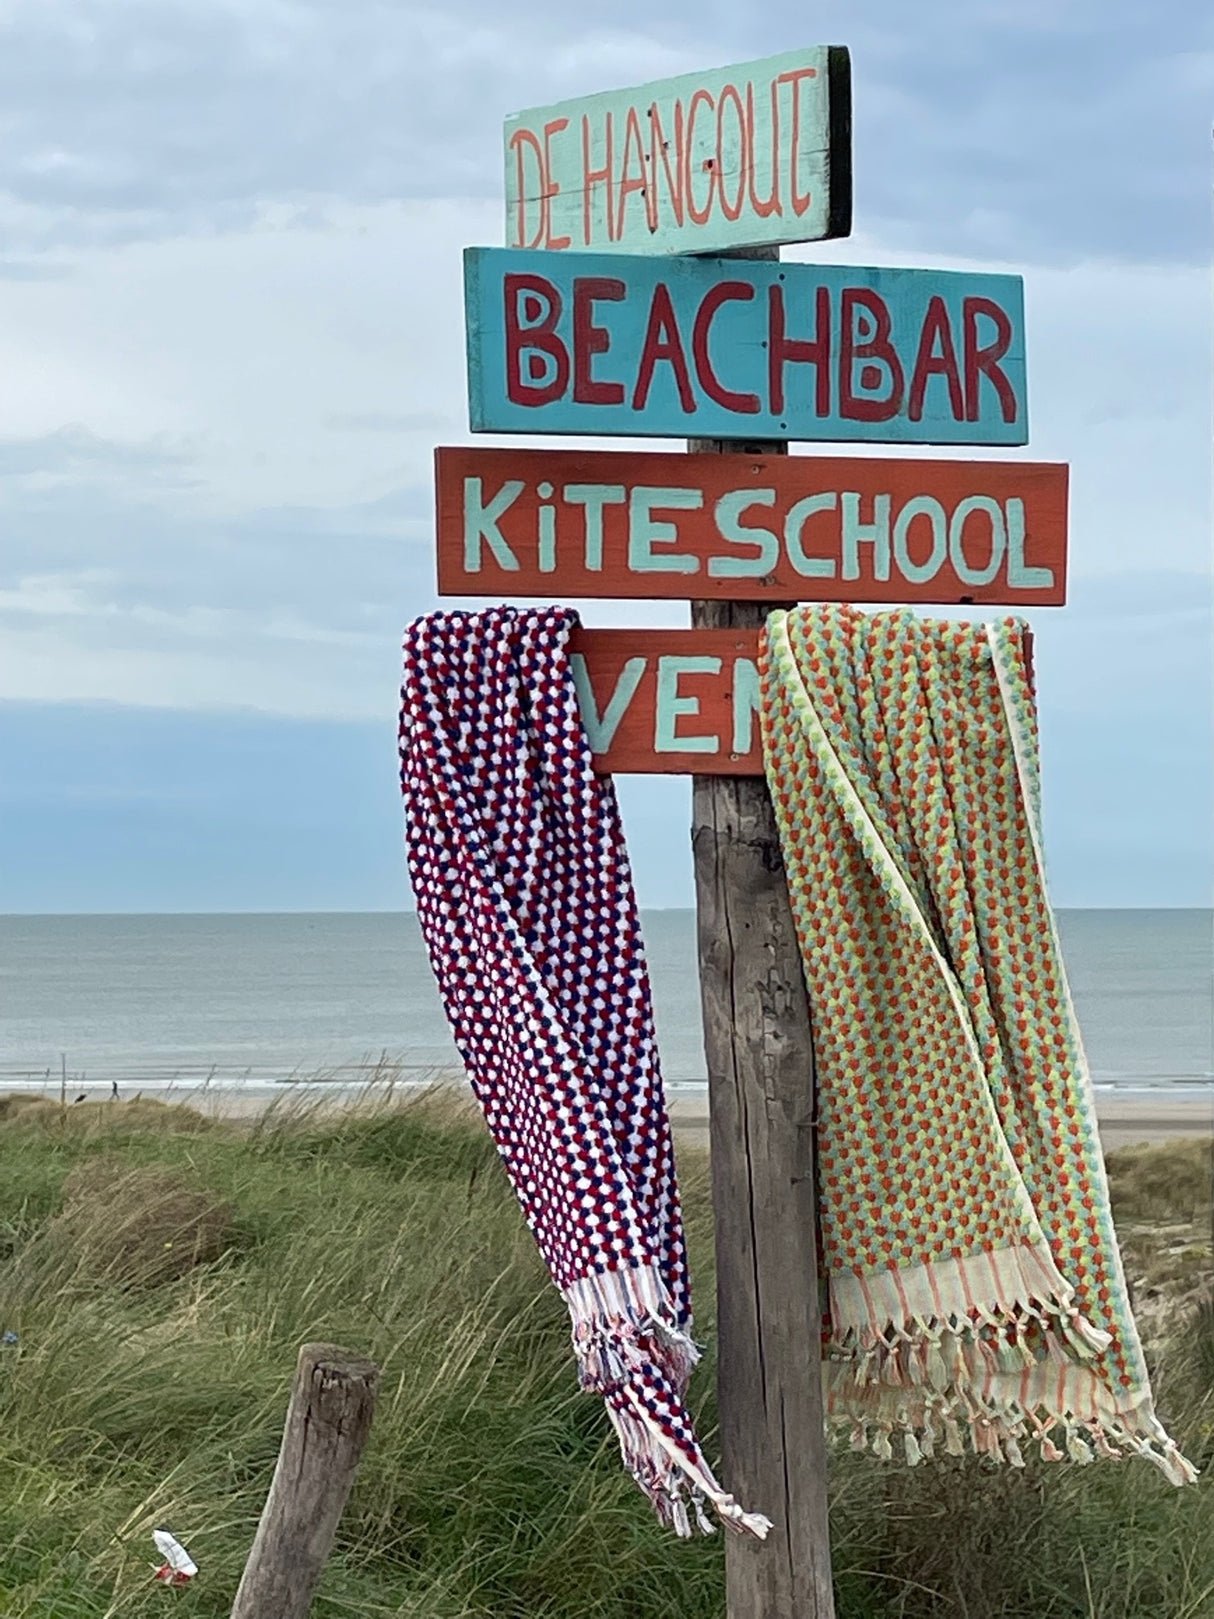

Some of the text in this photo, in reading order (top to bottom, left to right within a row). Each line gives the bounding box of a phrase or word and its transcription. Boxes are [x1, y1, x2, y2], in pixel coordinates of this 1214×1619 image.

[510, 68, 817, 250] DE HANGOUT
[504, 273, 1017, 424] BEACHBAR
